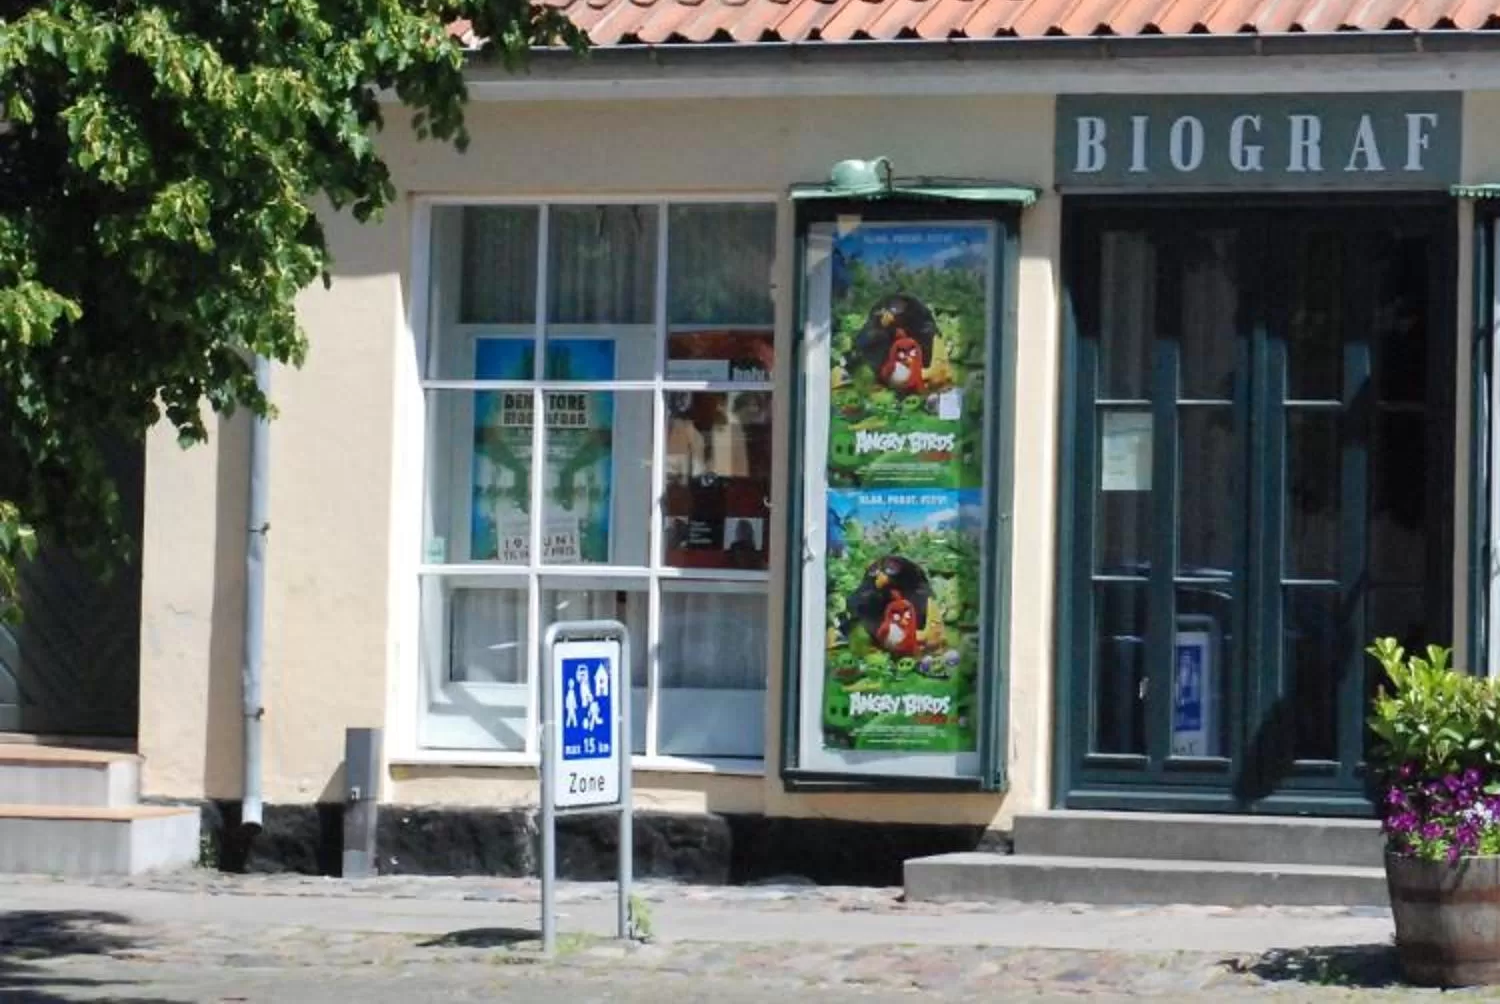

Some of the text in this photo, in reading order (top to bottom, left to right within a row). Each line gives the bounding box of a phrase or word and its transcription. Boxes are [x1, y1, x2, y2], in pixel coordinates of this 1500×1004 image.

[1073, 112, 1438, 174] BIOGRAF
[856, 429, 956, 455] ANGRY BIRDS
[849, 691, 950, 716] ANGRY BIRDS
[583, 737, 596, 753] 15
[569, 771, 606, 794] Zone
